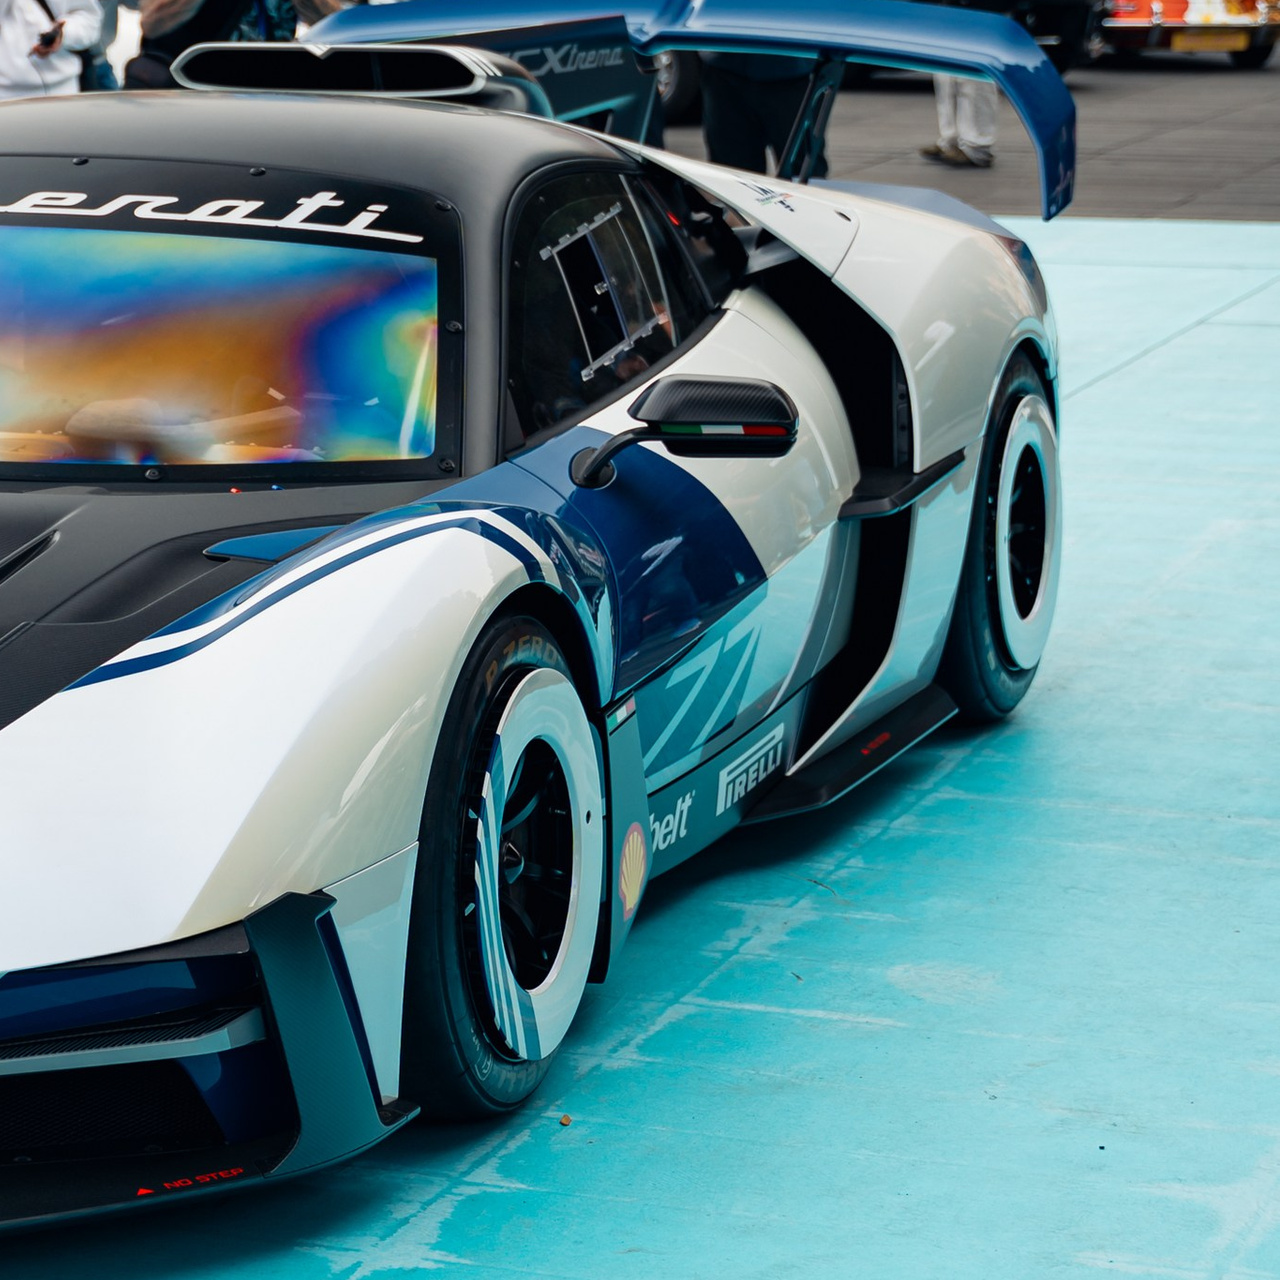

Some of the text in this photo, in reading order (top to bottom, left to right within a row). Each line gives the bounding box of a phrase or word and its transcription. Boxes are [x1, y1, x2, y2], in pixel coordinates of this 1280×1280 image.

[502, 43, 624, 77] CXtrema
[716, 722, 785, 817] PIRELLI
[163, 1167, 245, 1190] NO STEP
